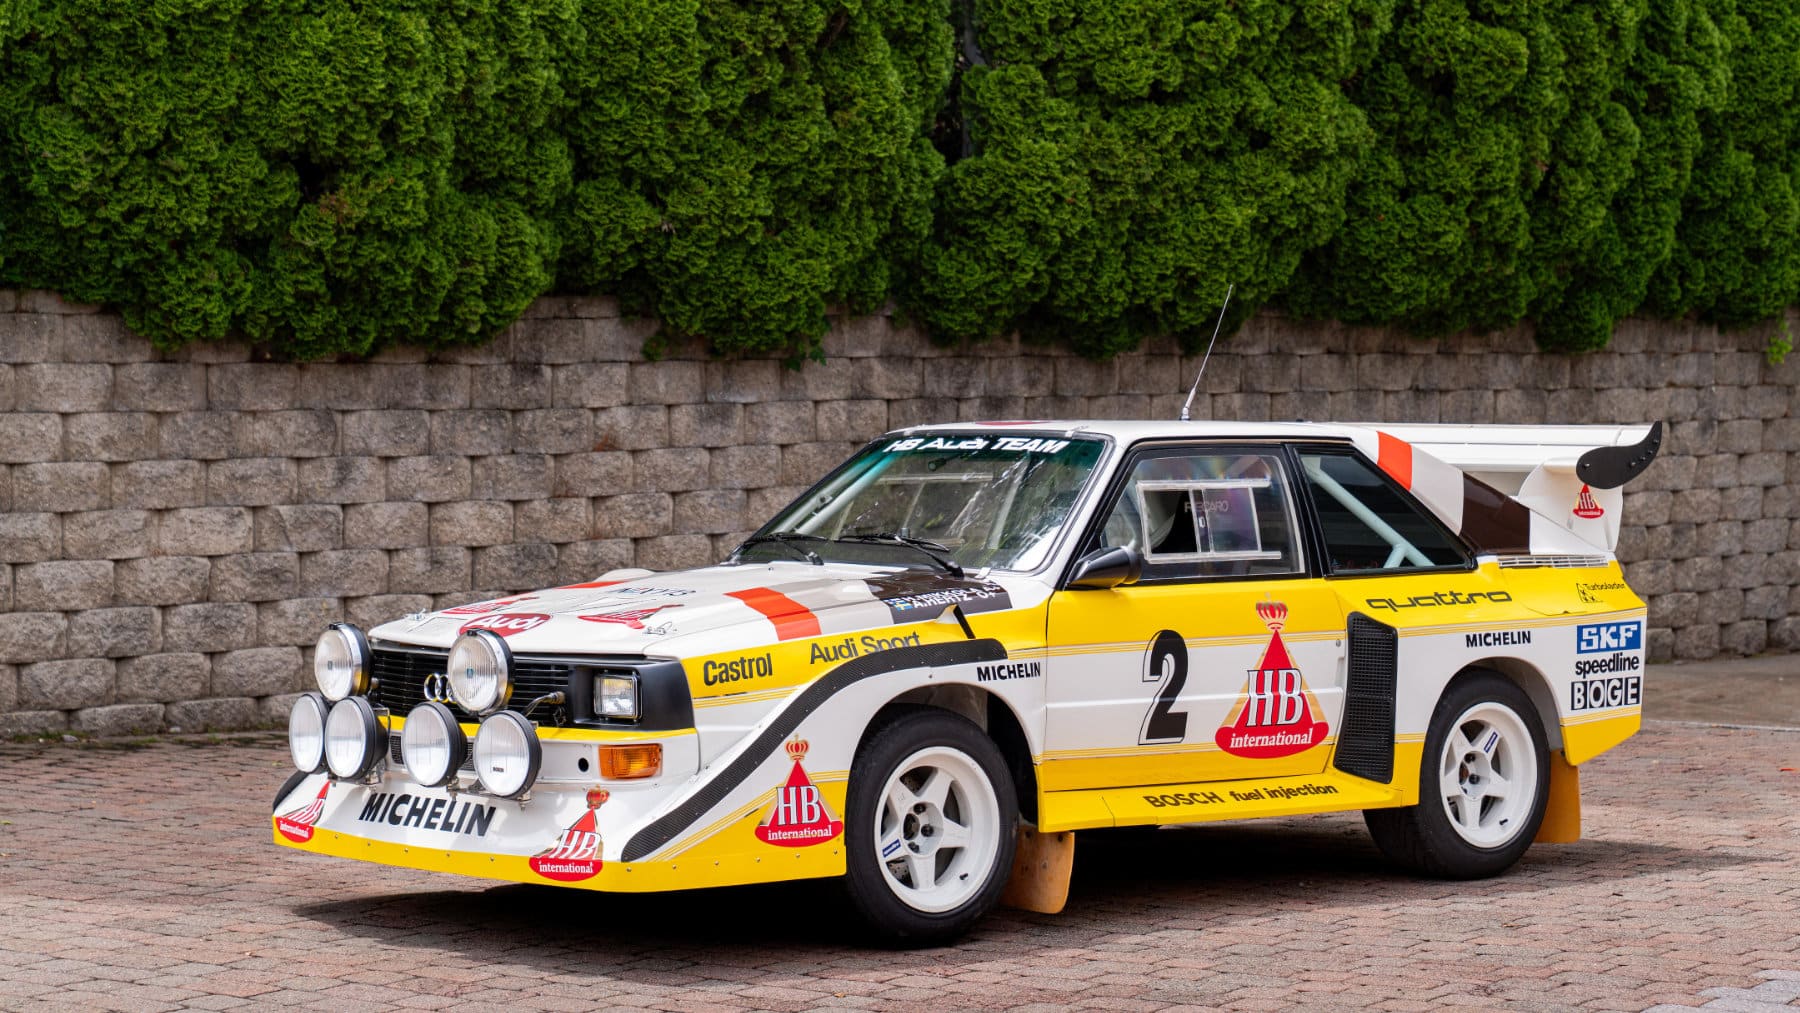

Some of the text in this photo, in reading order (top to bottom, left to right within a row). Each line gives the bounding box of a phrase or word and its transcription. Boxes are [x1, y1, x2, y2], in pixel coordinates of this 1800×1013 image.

[882, 436, 1071, 454] HB Audi TEAM
[1366, 590, 1512, 612] quattro
[464, 614, 545, 630] Audi
[810, 630, 920, 665] Audi Sport
[1466, 630, 1531, 648] MICHELIN
[1580, 624, 1638, 651] SKF
[703, 653, 774, 687] Castrol
[976, 661, 1041, 682] MICHELIN
[1575, 652, 1640, 679] speedline
[1138, 629, 1189, 746] 2
[1245, 668, 1304, 727] HB
[1572, 677, 1640, 710] BOGE
[1229, 728, 1313, 749] international
[776, 785, 821, 826] HB
[1143, 783, 1339, 808] BOSCH fuel injection
[358, 792, 497, 837] MICHELIN
[548, 828, 602, 860] HB
[767, 825, 833, 841] international
[538, 861, 594, 874] international
